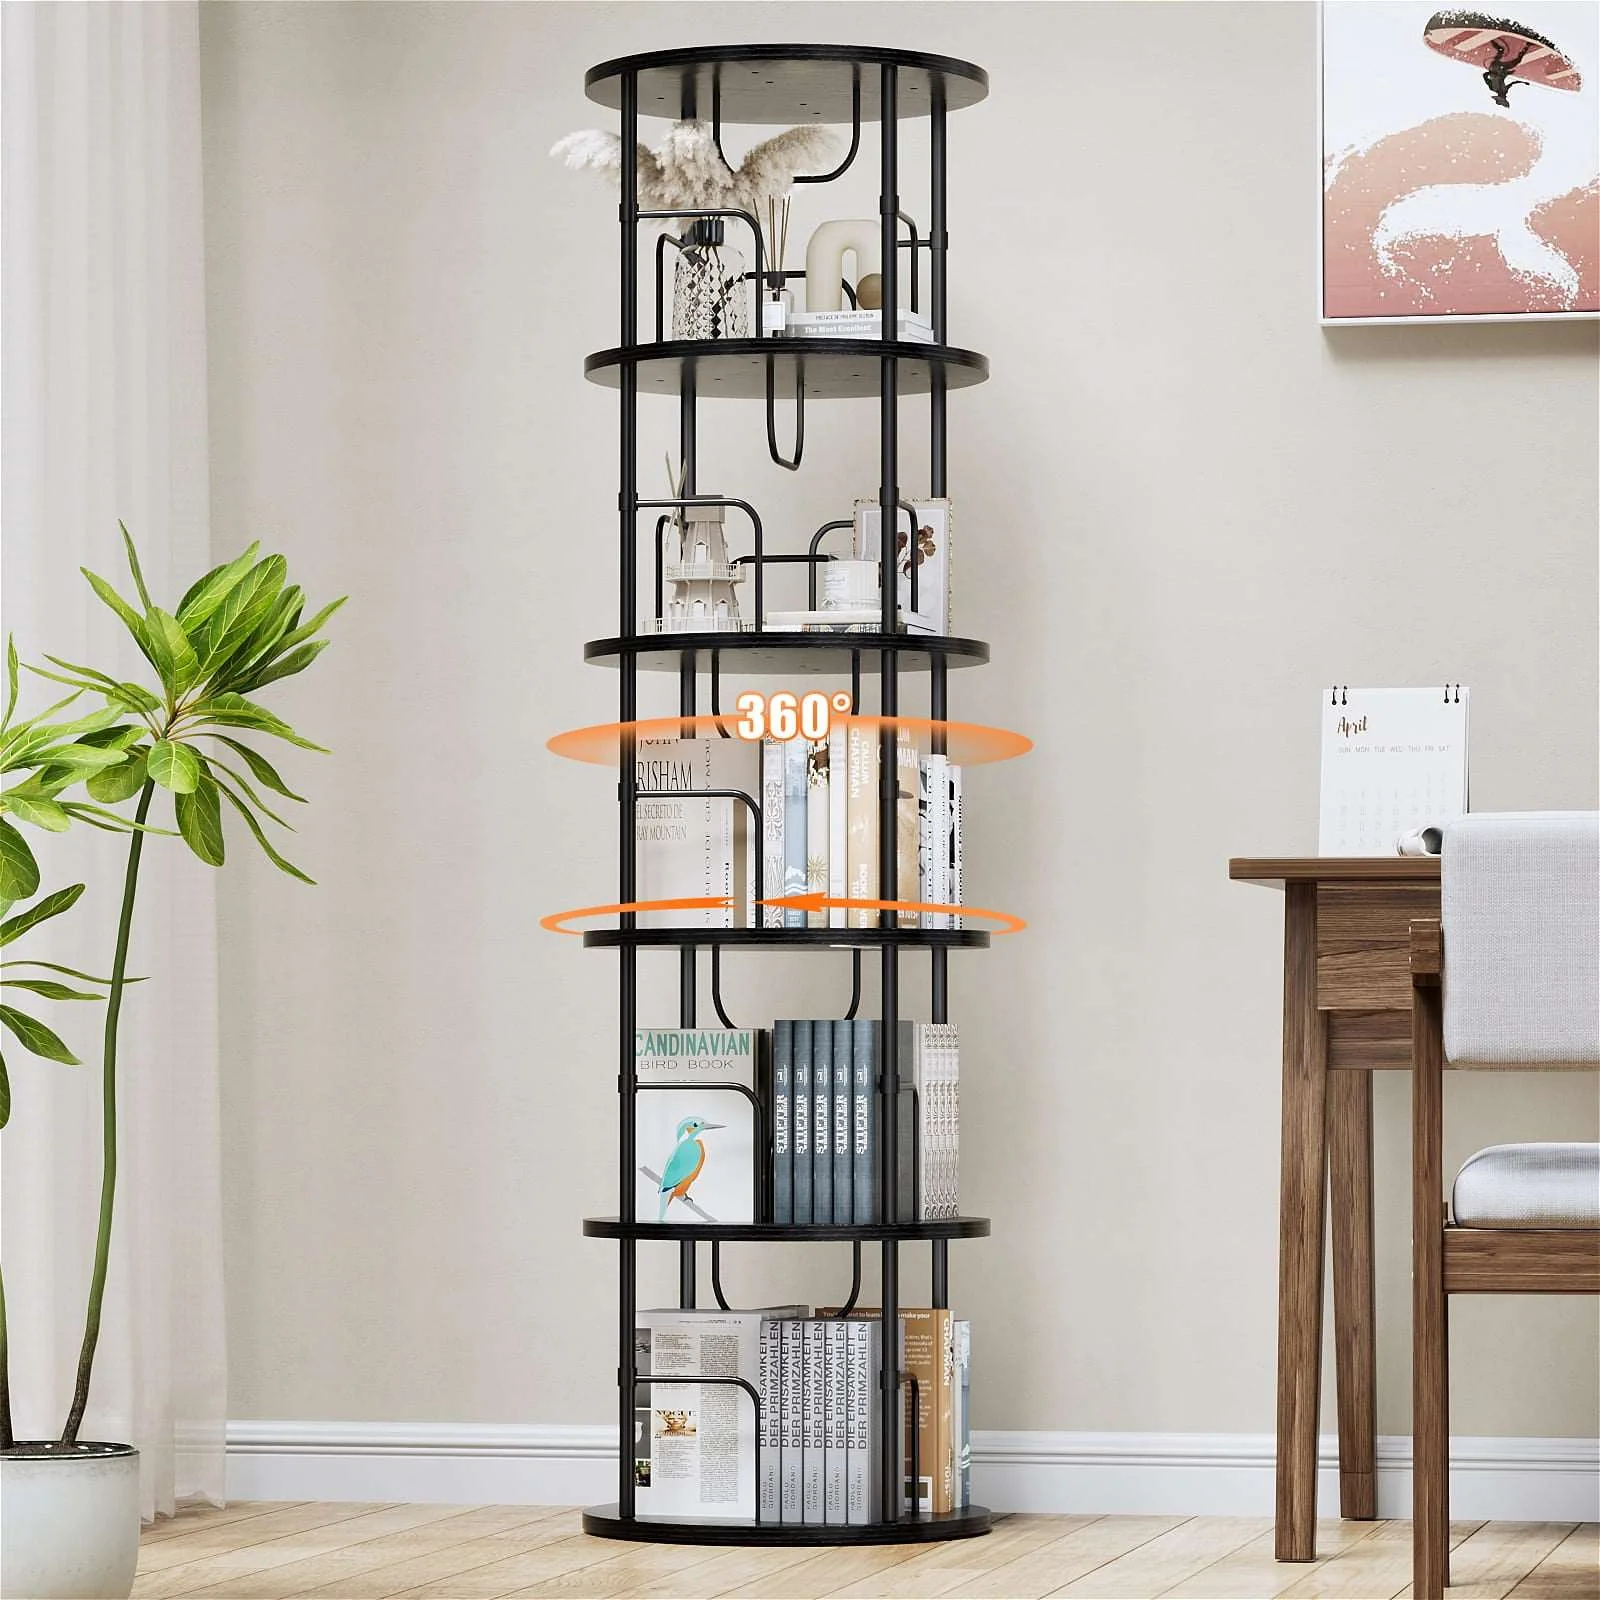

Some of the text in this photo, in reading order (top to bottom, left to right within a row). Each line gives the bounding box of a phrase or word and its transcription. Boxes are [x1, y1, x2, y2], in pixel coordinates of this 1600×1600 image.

[851, 728, 860, 798] CHAPMAN
[1338, 715, 1367, 738] April
[637, 761, 692, 791] RISHAM
[637, 825, 687, 840] RAY MOUNTAIN
[636, 1032, 749, 1056] CANDINAVIAN
[640, 1059, 735, 1070] BIRD BOOK
[770, 1322, 779, 1447] DER PRIMZAHLEN
[792, 1322, 800, 1448] DER PRIMZAHLEN
[803, 1337, 811, 1448] DIE EINSAMKEIT
[814, 1322, 822, 1448] DER PRIMZAHLEN
[836, 1323, 844, 1448] DER PRIMZAHLEN
[858, 1324, 866, 1449] DER PRIMZAHLEN
